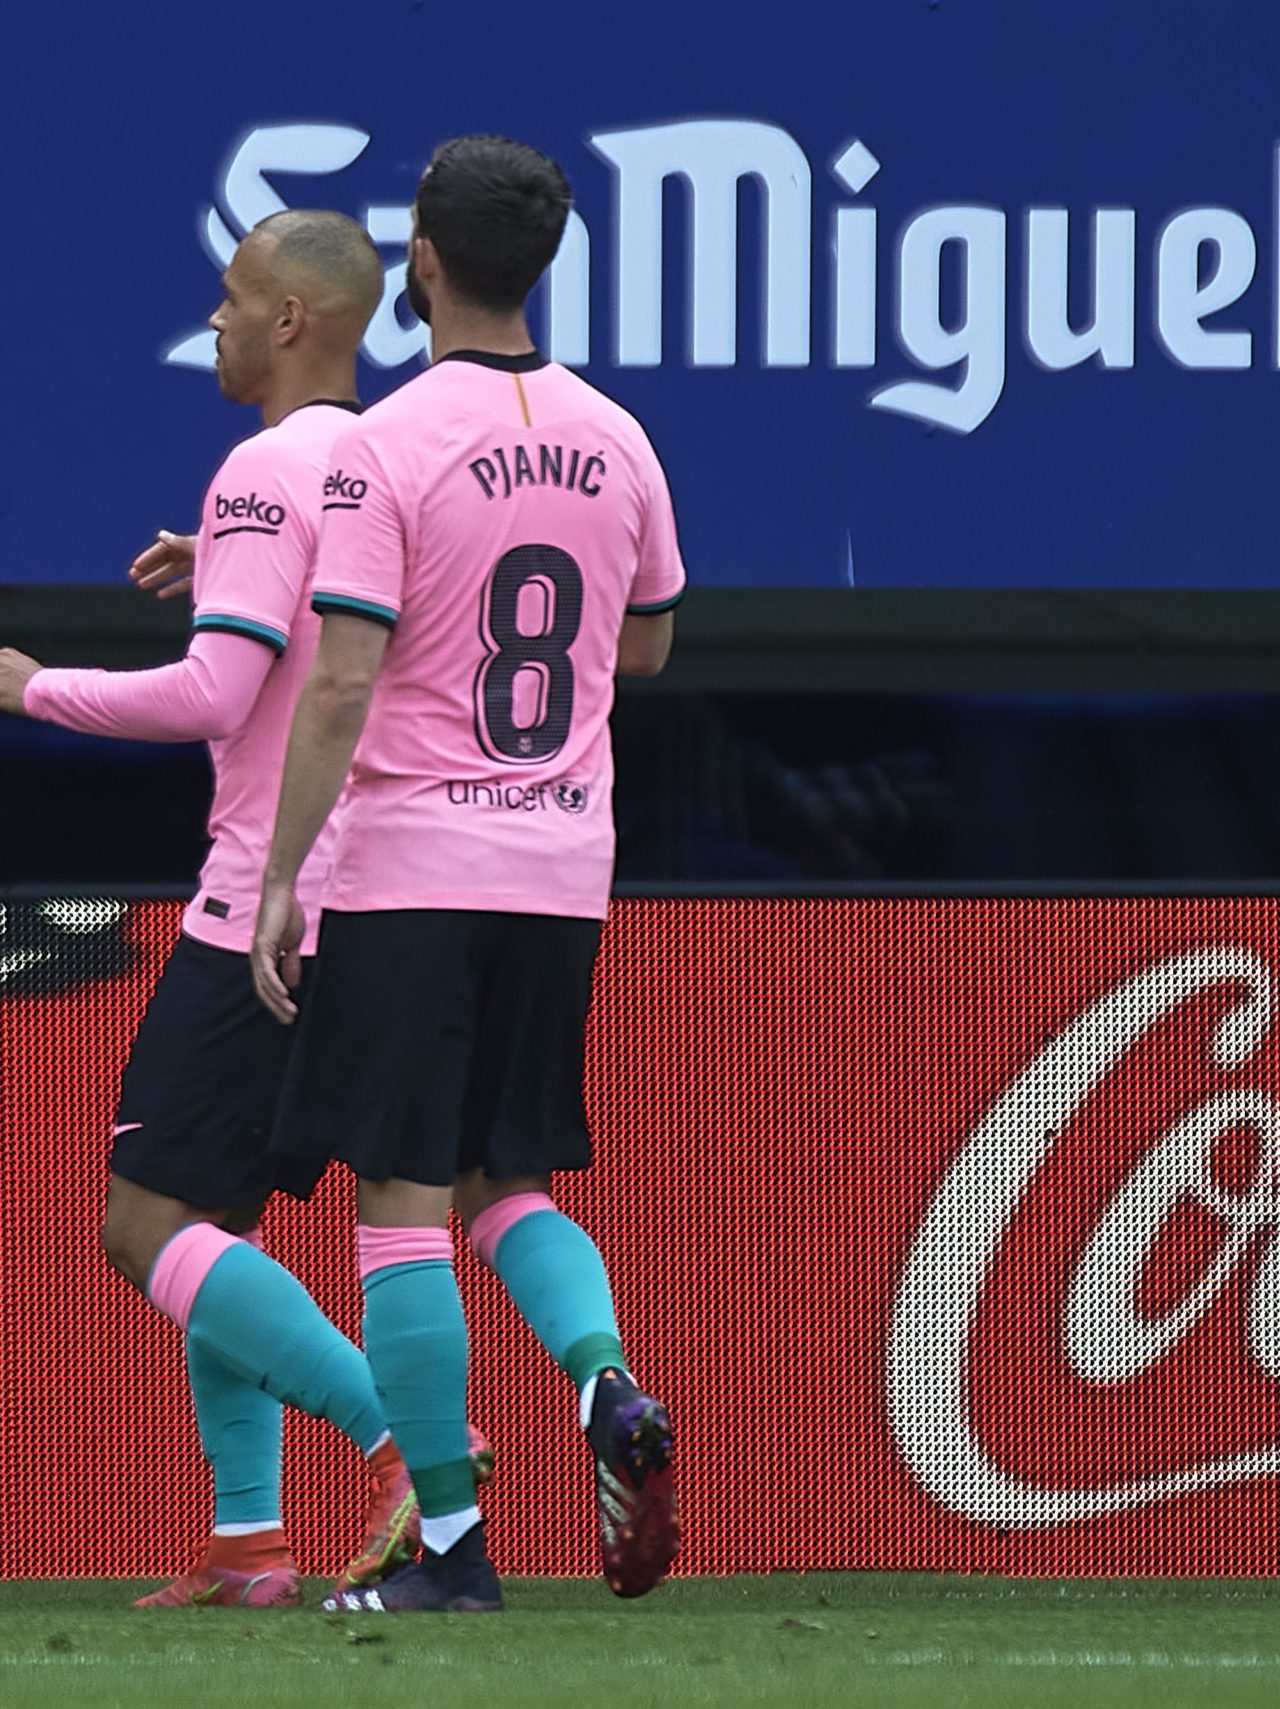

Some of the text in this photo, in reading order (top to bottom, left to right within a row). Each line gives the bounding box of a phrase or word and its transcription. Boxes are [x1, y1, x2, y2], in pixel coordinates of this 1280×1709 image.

[592, 119, 1280, 433] Migue
[323, 470, 368, 500] eko
[469, 444, 607, 501] PJANIĆ
[215, 493, 286, 527] beko
[473, 543, 585, 766] 8
[447, 780, 551, 811] unicef
